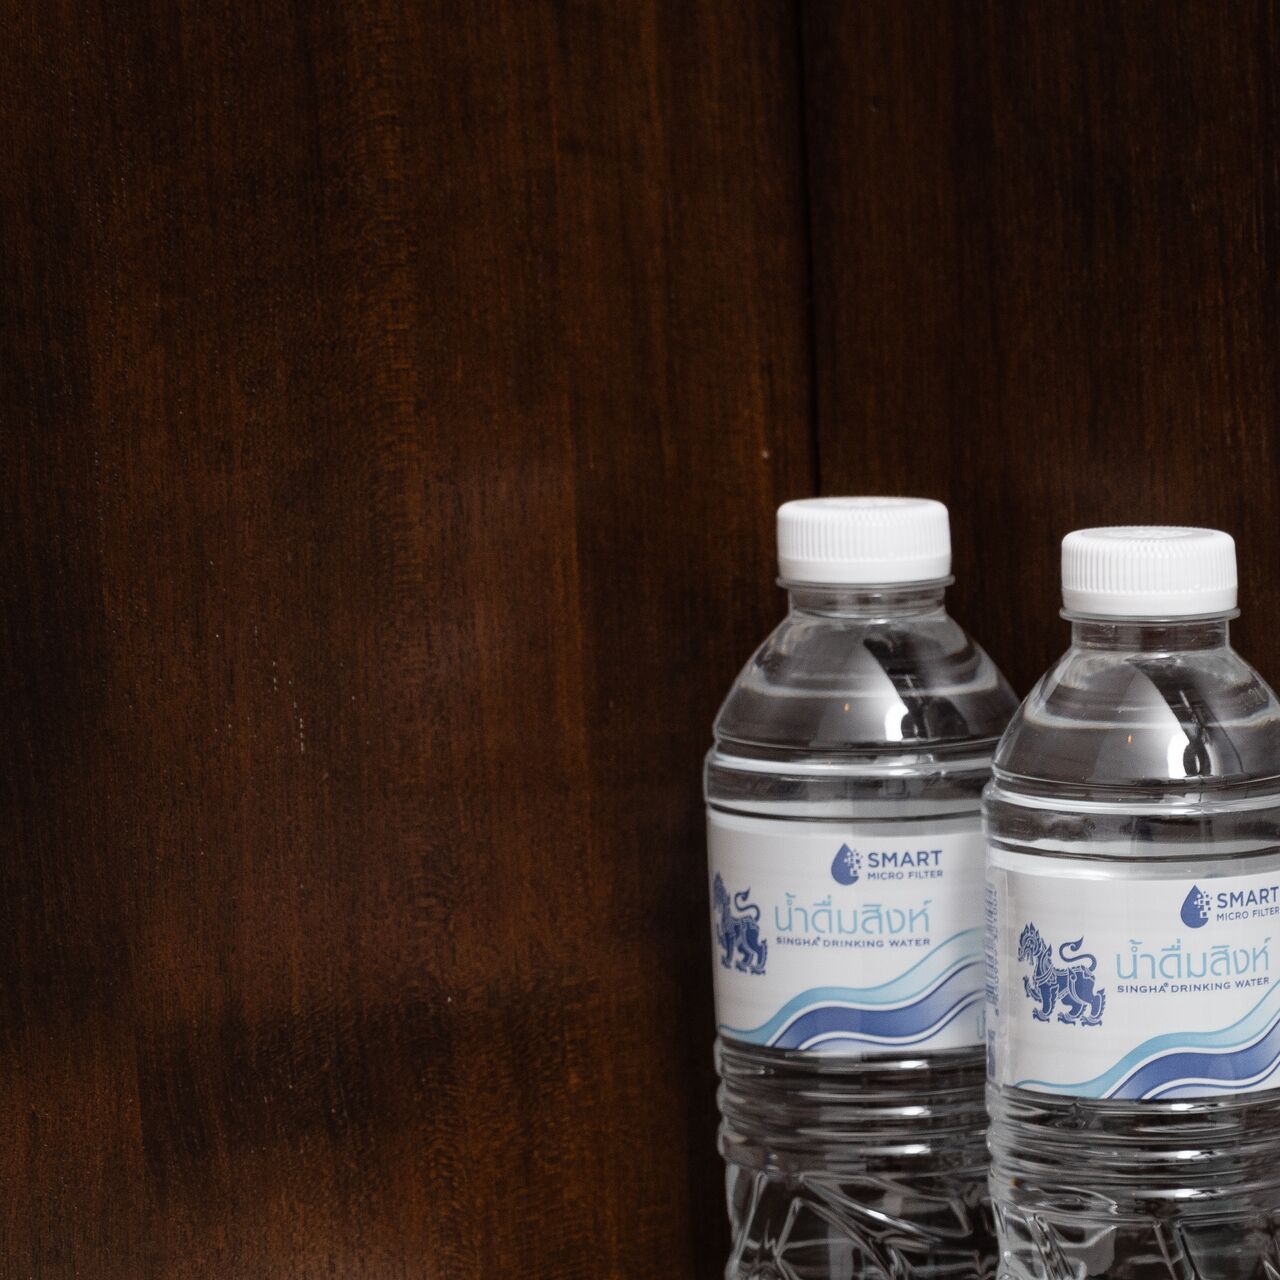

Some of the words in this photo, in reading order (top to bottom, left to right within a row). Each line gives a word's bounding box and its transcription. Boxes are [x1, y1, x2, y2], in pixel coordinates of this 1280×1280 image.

[868, 850, 943, 868] SMART
[867, 871, 904, 881] MICRO
[908, 869, 944, 880] FILTER
[1217, 886, 1279, 908] SMART
[775, 892, 932, 934] น้ำดื่มสิงห์
[1216, 911, 1249, 921] MICRO
[1252, 906, 1280, 917] FILTER
[823, 939, 884, 948] DRINKING
[889, 938, 931, 947] WATER
[1116, 936, 1272, 979] น้ำดื่มสิงห์
[1171, 982, 1231, 993] DRINKING
[1235, 977, 1270, 988] WATER
